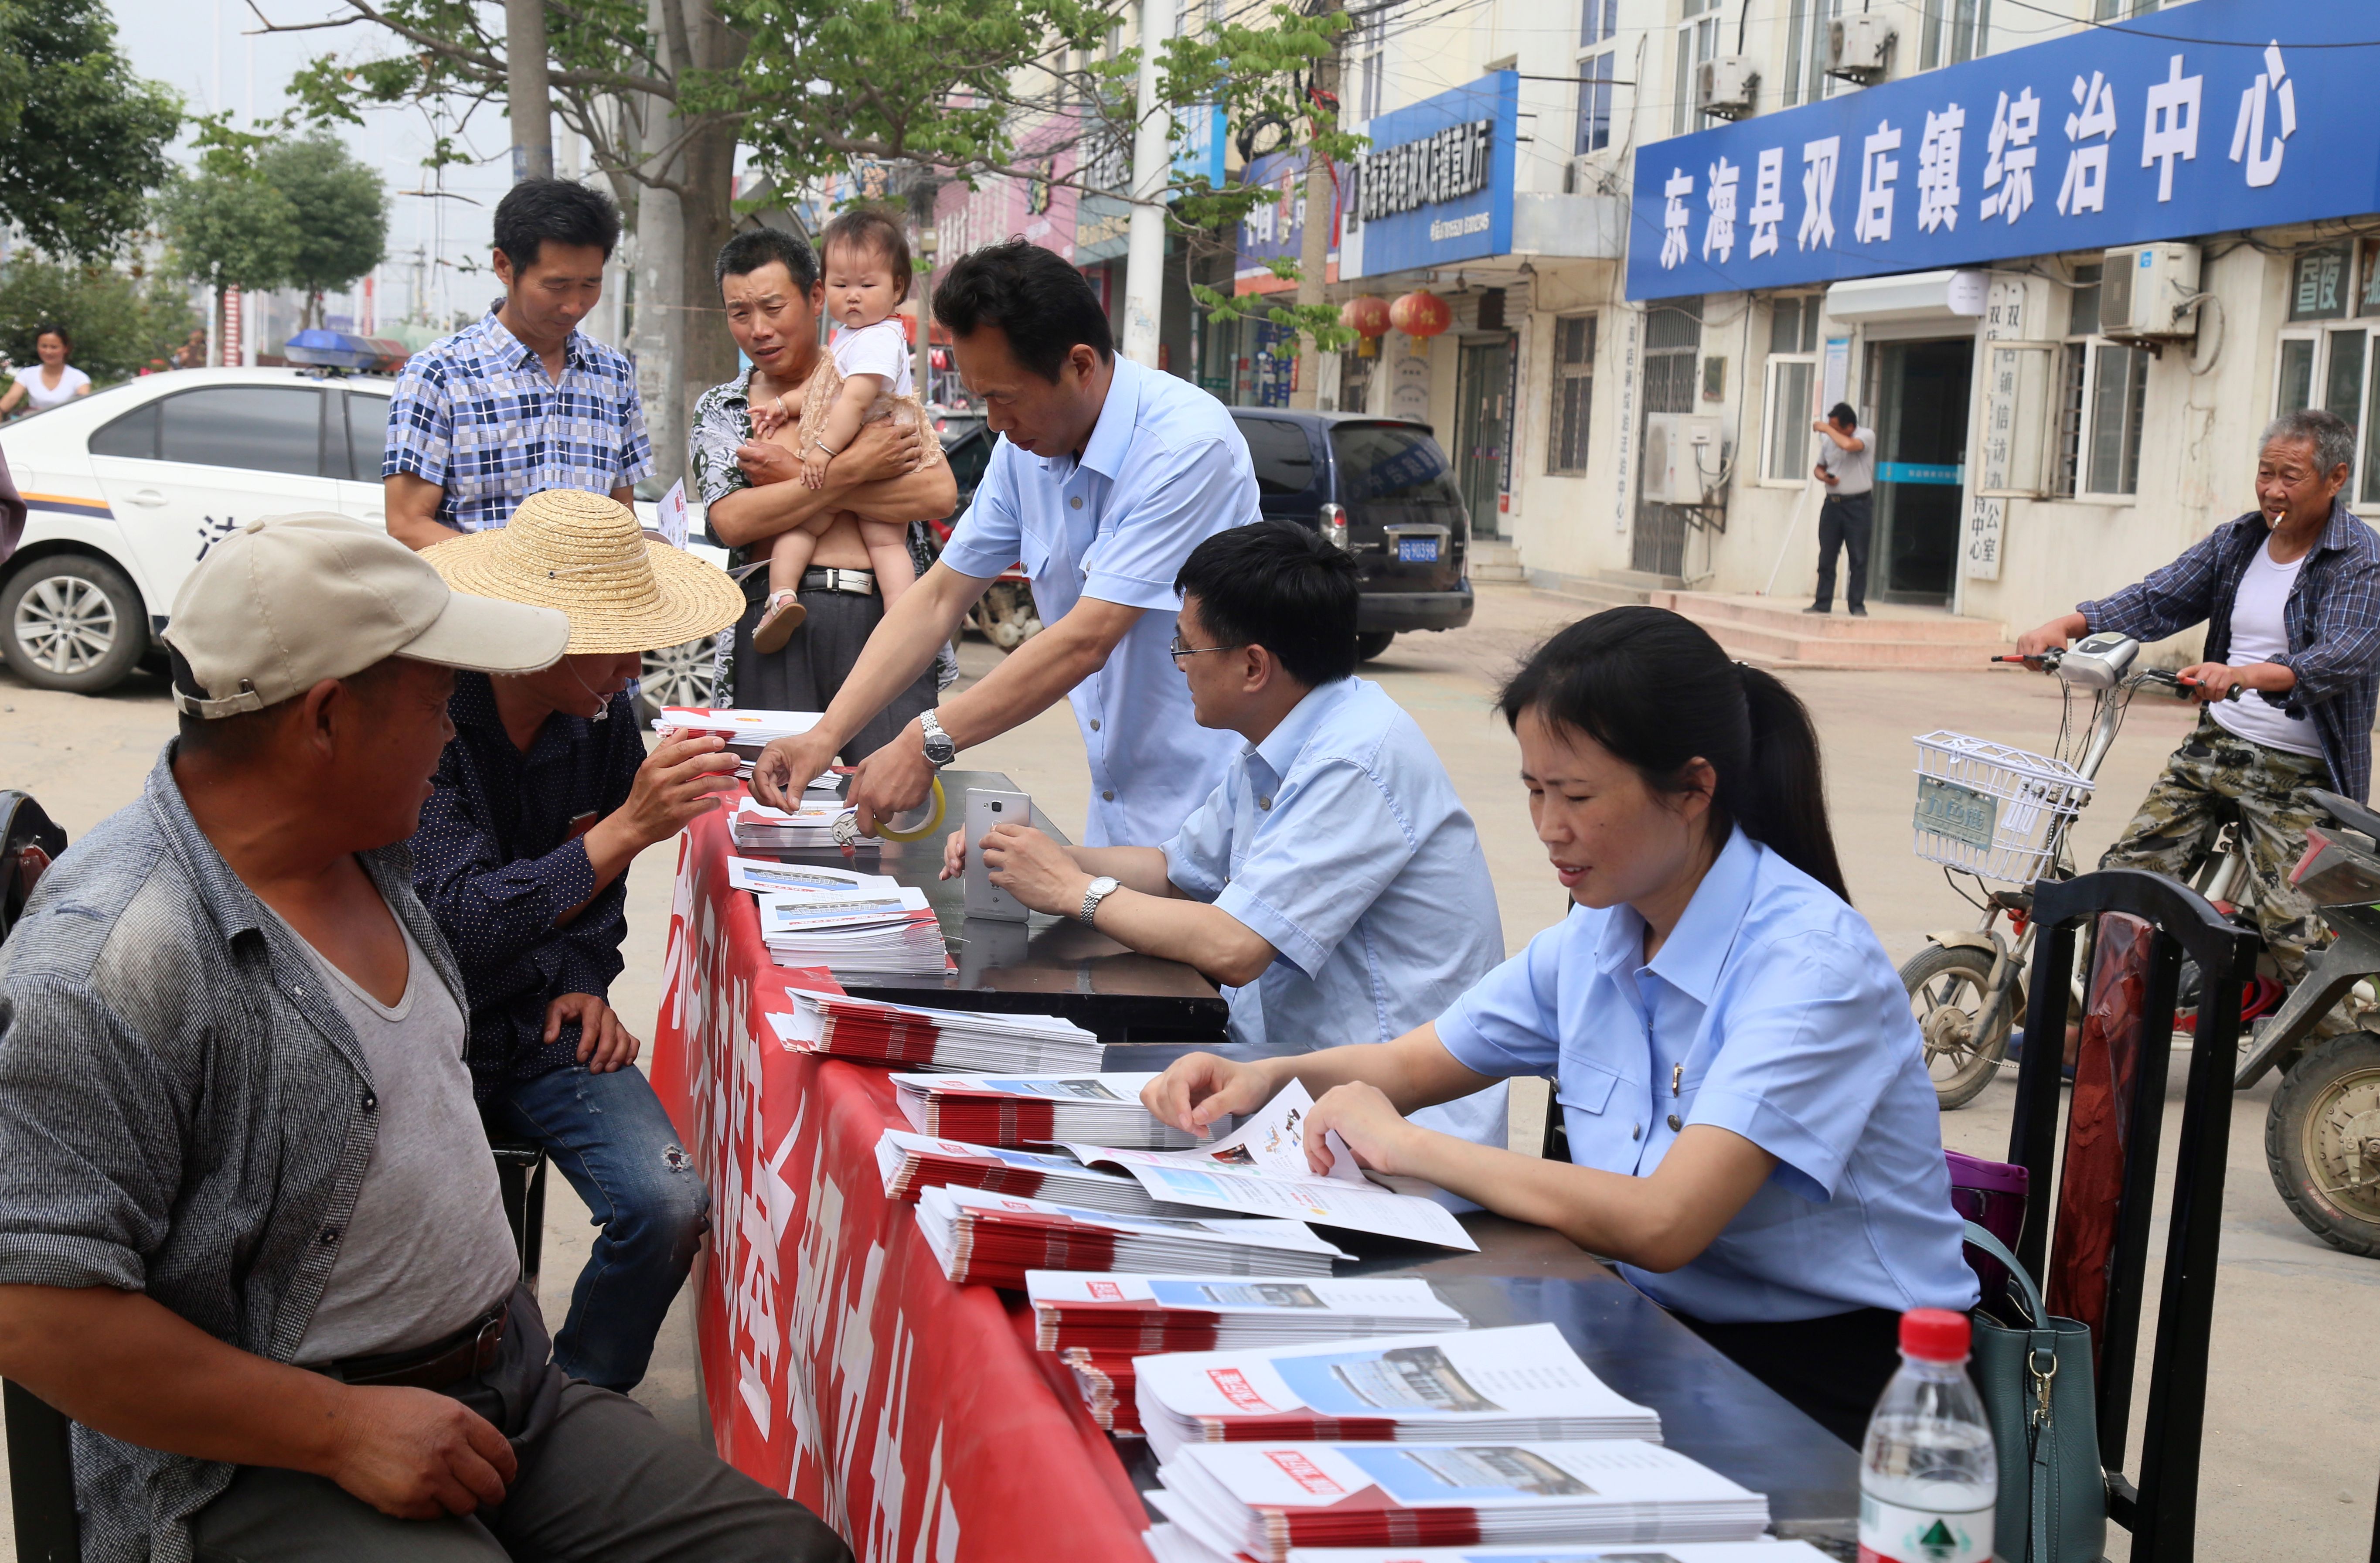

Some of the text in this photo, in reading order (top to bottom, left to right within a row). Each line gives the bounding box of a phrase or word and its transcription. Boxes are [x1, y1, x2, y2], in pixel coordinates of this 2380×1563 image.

[1659, 38, 2297, 271] 东海县双店镇综治中心
[1926, 792, 1986, 831] 九色鹿
